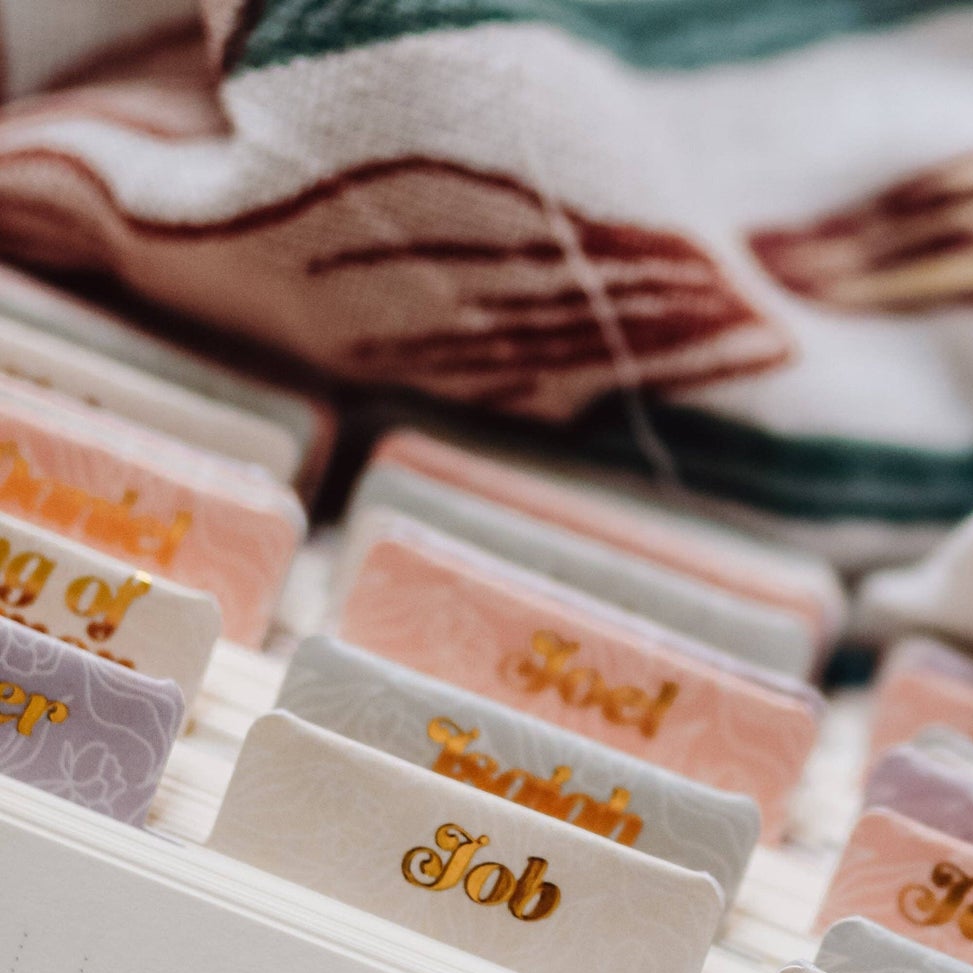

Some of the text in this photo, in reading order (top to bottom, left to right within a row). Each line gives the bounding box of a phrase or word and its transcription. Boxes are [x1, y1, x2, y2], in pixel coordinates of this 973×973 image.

[65, 569, 152, 642] of
[497, 628, 679, 740] Joel
[402, 822, 561, 922] Job
